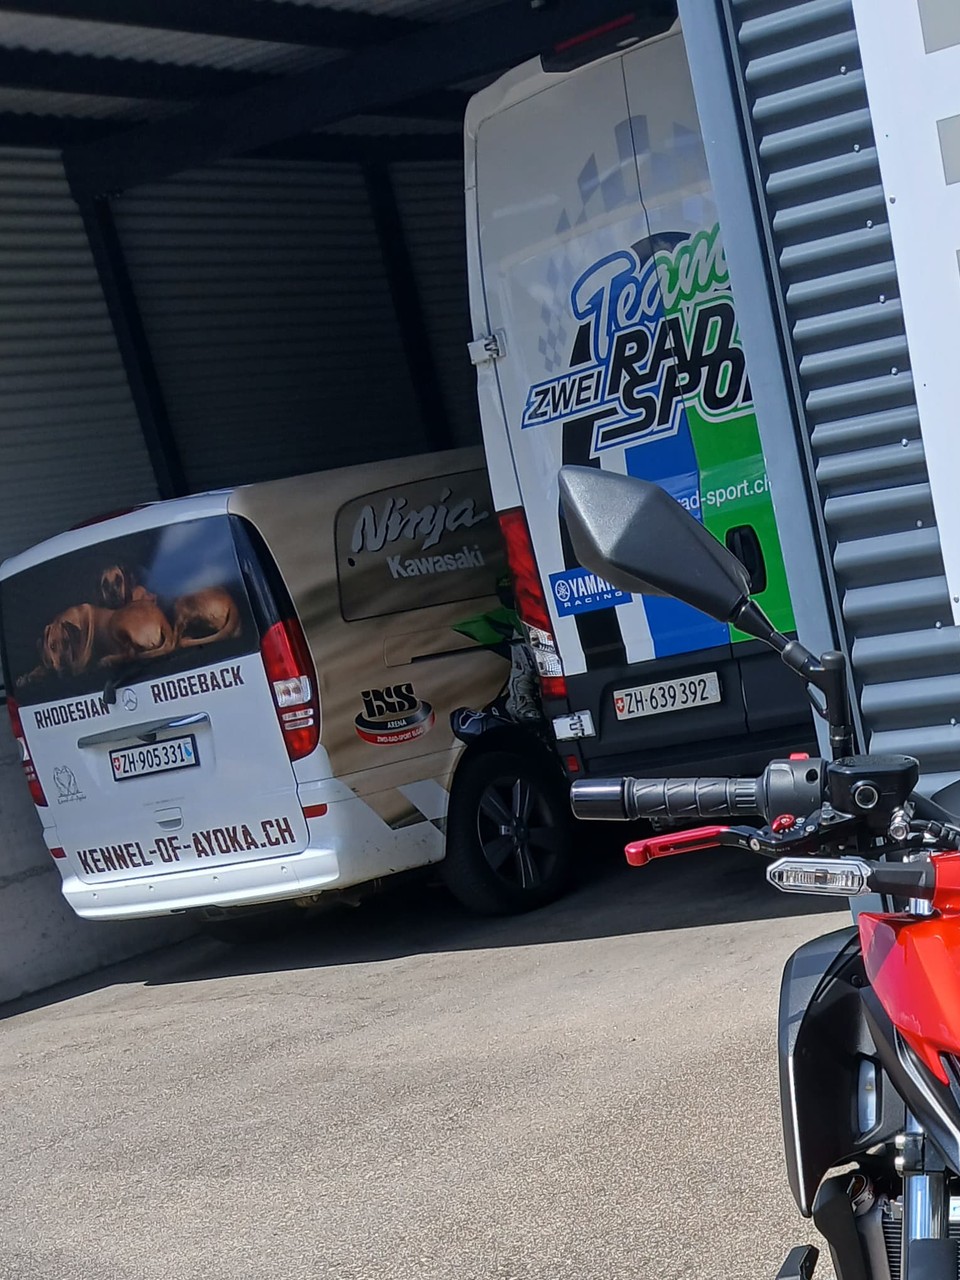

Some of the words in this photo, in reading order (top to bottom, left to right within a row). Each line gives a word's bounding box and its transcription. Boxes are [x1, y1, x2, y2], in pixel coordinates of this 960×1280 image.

[607, 302, 735, 397] RAD
[527, 370, 602, 421] ZWEI
[600, 346, 753, 444] SPO
[351, 487, 489, 553] Ninja
[386, 545, 485, 579] Kawasaki
[563, 590, 623, 608] RACING
[34, 696, 110, 729] RHODESIAN
[151, 665, 245, 704] RIDGEBACK
[387, 718, 407, 729] ARENA
[77, 817, 296, 875] KENNEL-OF-AYOKA.CH
